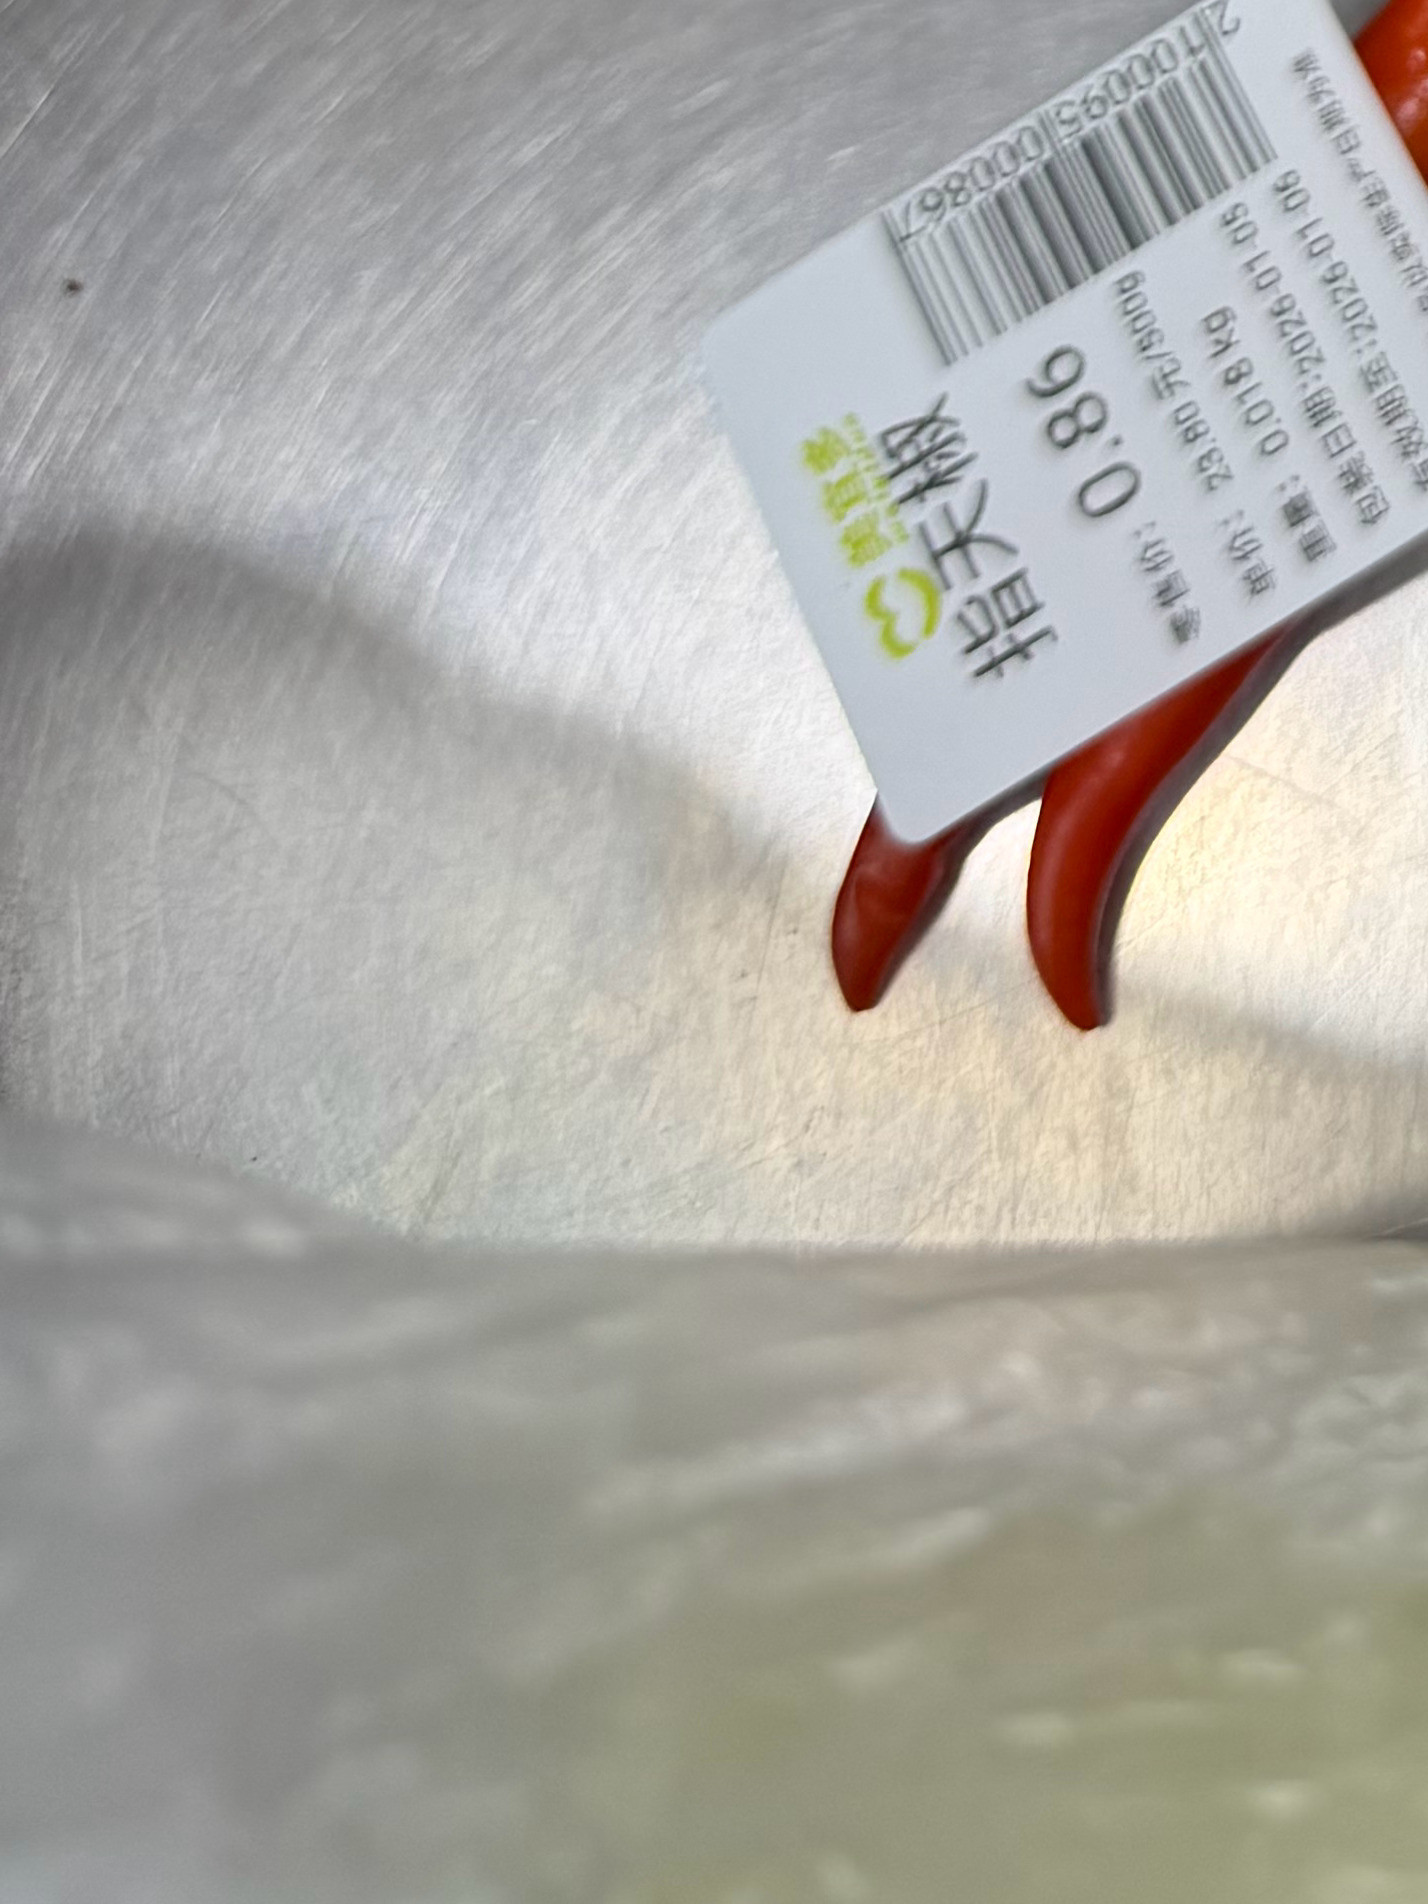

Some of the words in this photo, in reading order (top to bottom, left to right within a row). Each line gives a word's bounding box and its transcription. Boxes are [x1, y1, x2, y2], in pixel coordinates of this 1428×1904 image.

[877, 394, 1059, 680] 指天椒
[1023, 344, 1142, 522] 0.86
